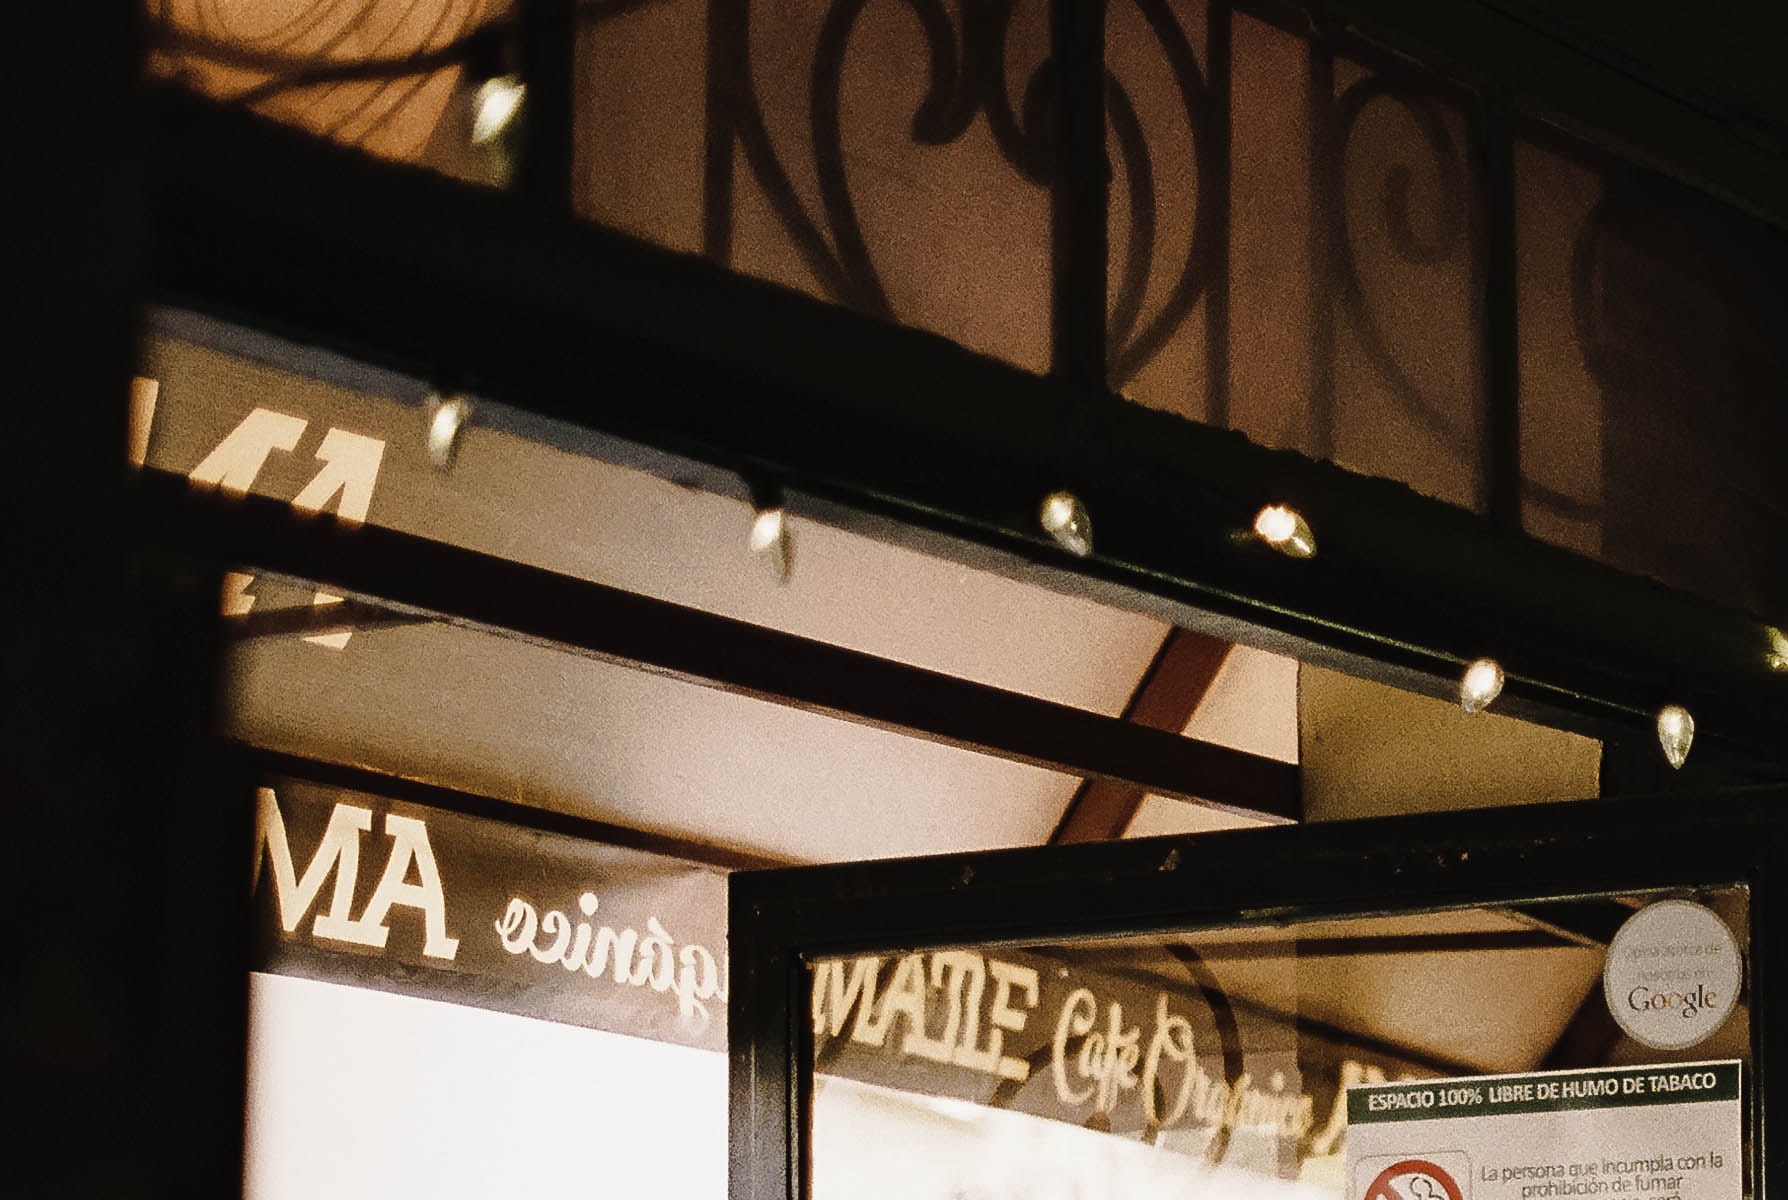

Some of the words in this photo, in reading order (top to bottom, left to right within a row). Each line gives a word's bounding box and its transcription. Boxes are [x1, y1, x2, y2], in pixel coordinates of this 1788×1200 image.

[1628, 984, 1718, 1019] Google
[1368, 1091, 1434, 1112] ESPACIO
[1439, 1086, 1483, 1107] 100%
[1488, 1083, 1533, 1103] LIBRE
[1536, 1082, 1560, 1101] DE
[1562, 1076, 1619, 1098] HUMO
[1622, 1076, 1645, 1094] DE
[1648, 1071, 1717, 1092] TABACO
[1482, 1166, 1499, 1182] La
[1502, 1161, 1565, 1184] persona
[1569, 1160, 1599, 1178] que
[1602, 1153, 1673, 1176] incumpla
[1676, 1153, 1706, 1171] con
[1710, 1150, 1724, 1169] la
[1521, 1176, 1609, 1200] prohibición
[1611, 1174, 1633, 1193] de
[1636, 1172, 1685, 1191] fumar
